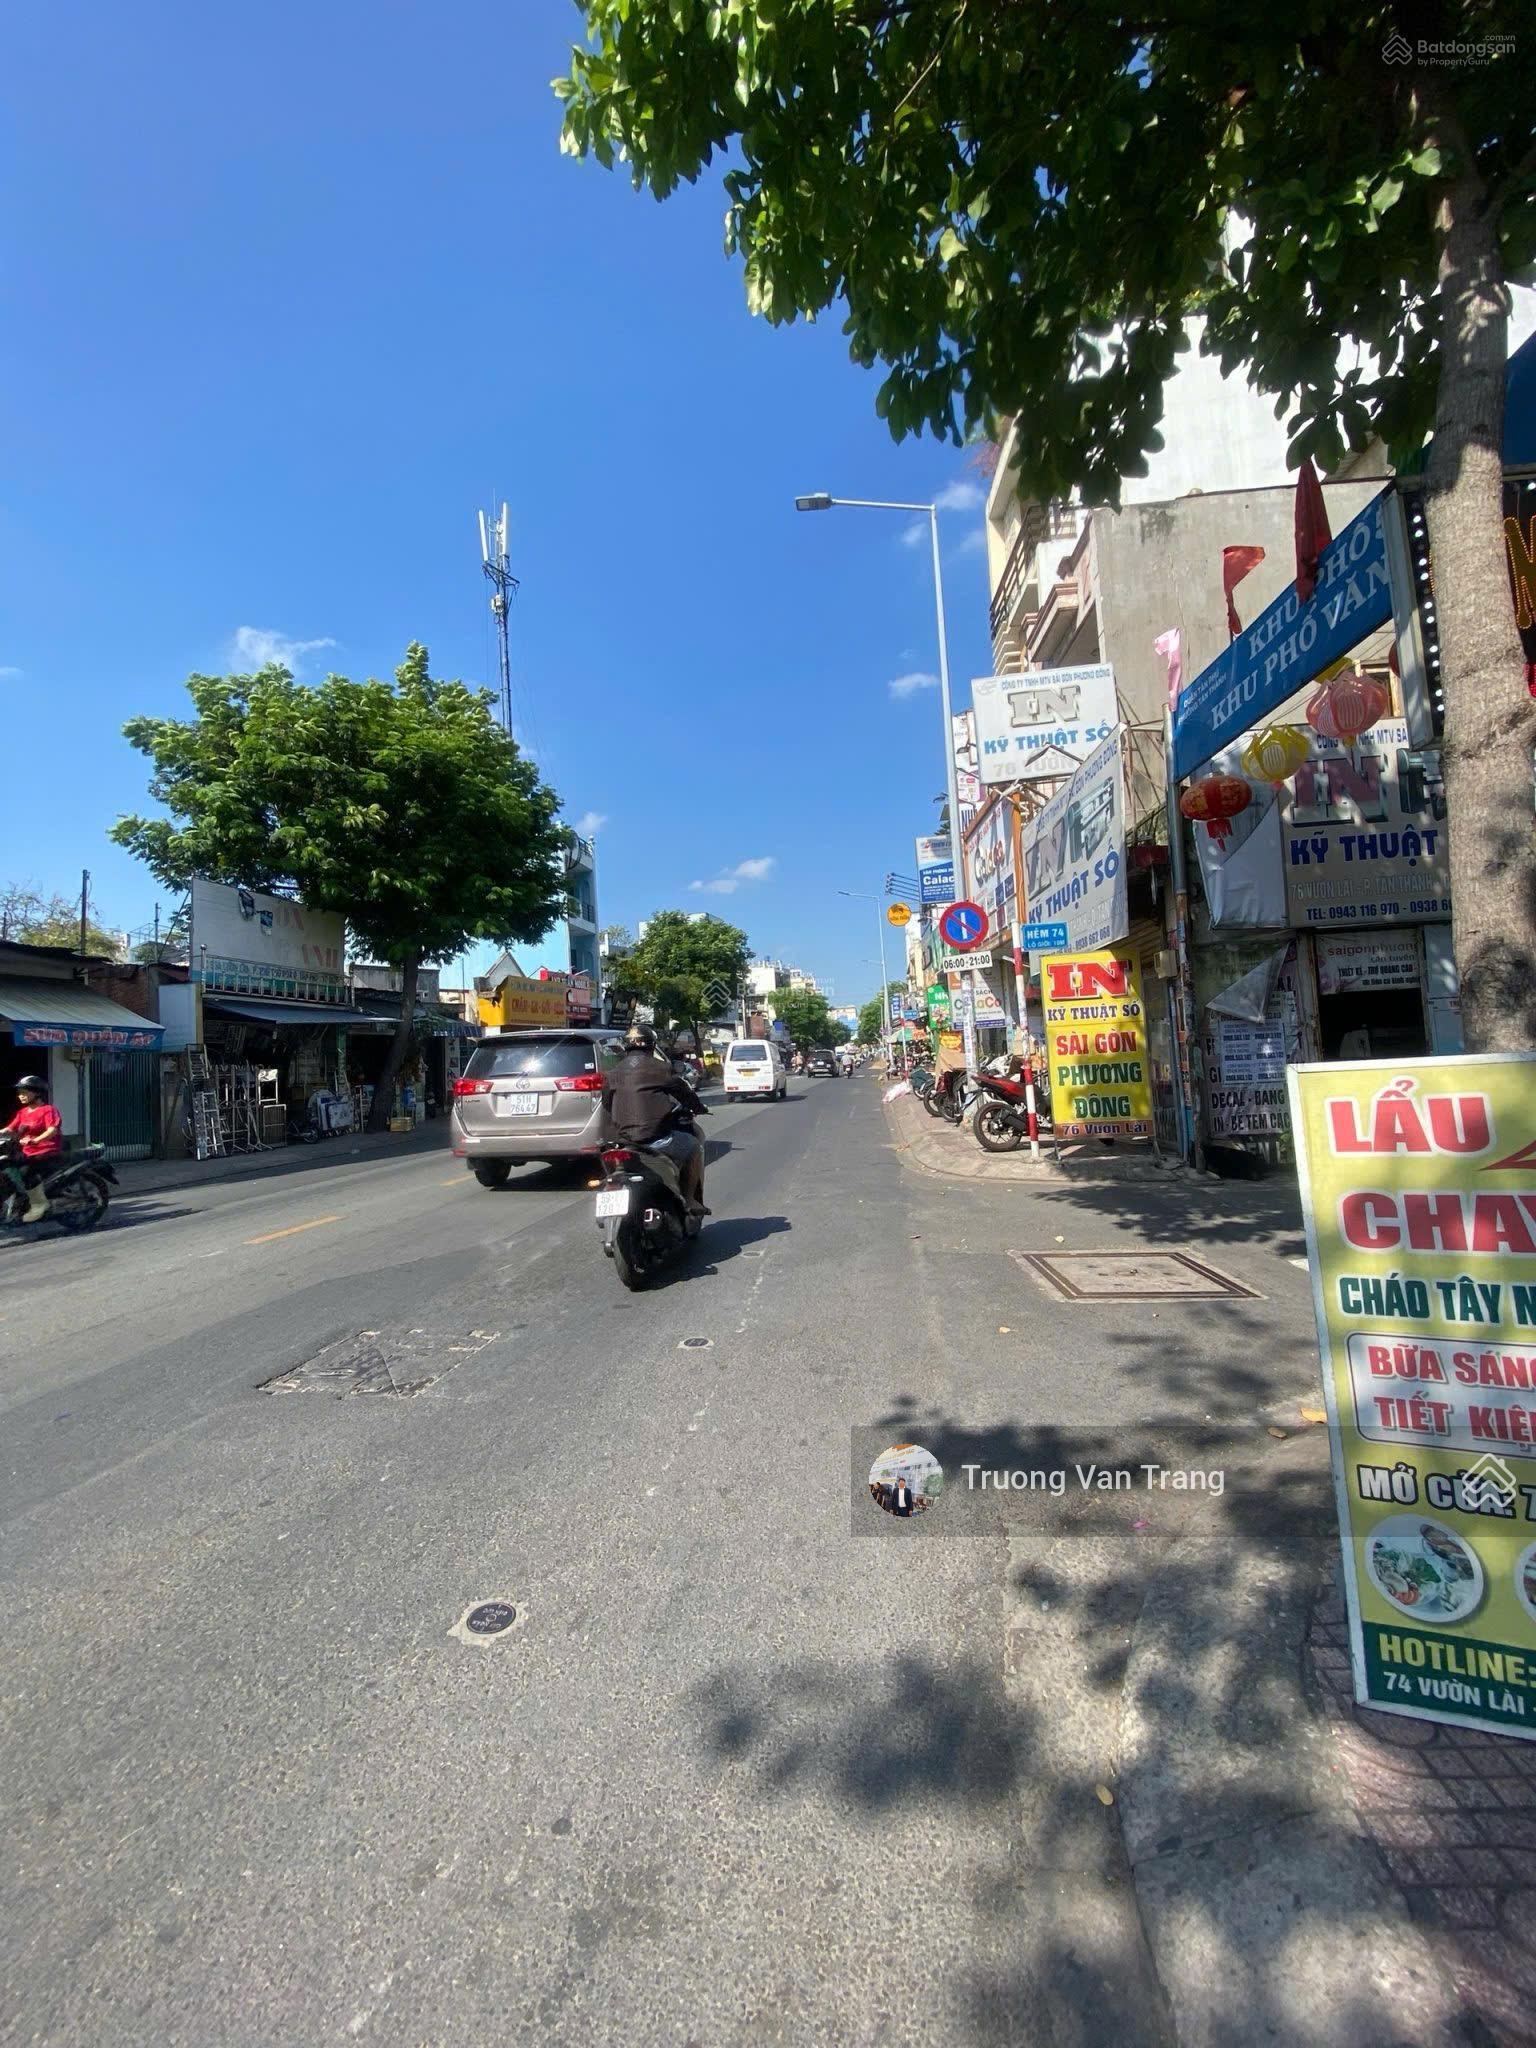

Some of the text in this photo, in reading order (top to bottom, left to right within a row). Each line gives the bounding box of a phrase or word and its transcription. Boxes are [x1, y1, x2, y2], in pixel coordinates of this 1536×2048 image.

[1249, 591, 1301, 661] KHU
[1211, 670, 1259, 731] KHU
[1264, 602, 1318, 686] PHỐ
[1007, 684, 1082, 729] IN
[1085, 718, 1113, 742] SỐ
[1396, 722, 1409, 744] SÀ
[1290, 823, 1438, 867] KỸ THUẬT
[923, 875, 955, 886] Calac
[1046, 871, 1090, 919] THUẬT
[1094, 838, 1120, 888] SỐ
[1307, 907, 1327, 921] TEL:
[1329, 905, 1357, 919] 0943
[1359, 904, 1378, 917] 116
[1380, 902, 1399, 916] 970
[1410, 900, 1438, 914] 0938
[1026, 926, 1065, 940] HẺM 74
[943, 958, 965, 970] 06:00
[969, 954, 990, 967] 21:00
[1047, 960, 1132, 1002] IN
[1070, 1003, 1118, 1022] THUẬT
[1122, 999, 1141, 1017] SỐ
[1056, 1026, 1137, 1056] SÀI GÒN
[1058, 1062, 1143, 1087] PHƯƠNG
[1074, 1093, 1131, 1119] ĐÔNG
[1211, 1090, 1246, 1109] DECAL
[1062, 1124, 1079, 1136] 76
[1245, 1113, 1268, 1131] TEM
[1330, 1079, 1491, 1154] LẨU
[1339, 1272, 1431, 1320] CHÁO
[1436, 1276, 1501, 1324] TÂY
[1368, 1343, 1445, 1382] BỮA
[1373, 1390, 1536, 1448] TIẾT KIỆ
[1358, 1463, 1416, 1502] MỞ
[1383, 1672, 1413, 1692] 74
[1418, 1675, 1481, 1707] VƯỜN
[1488, 1684, 1525, 1715] LÀI
